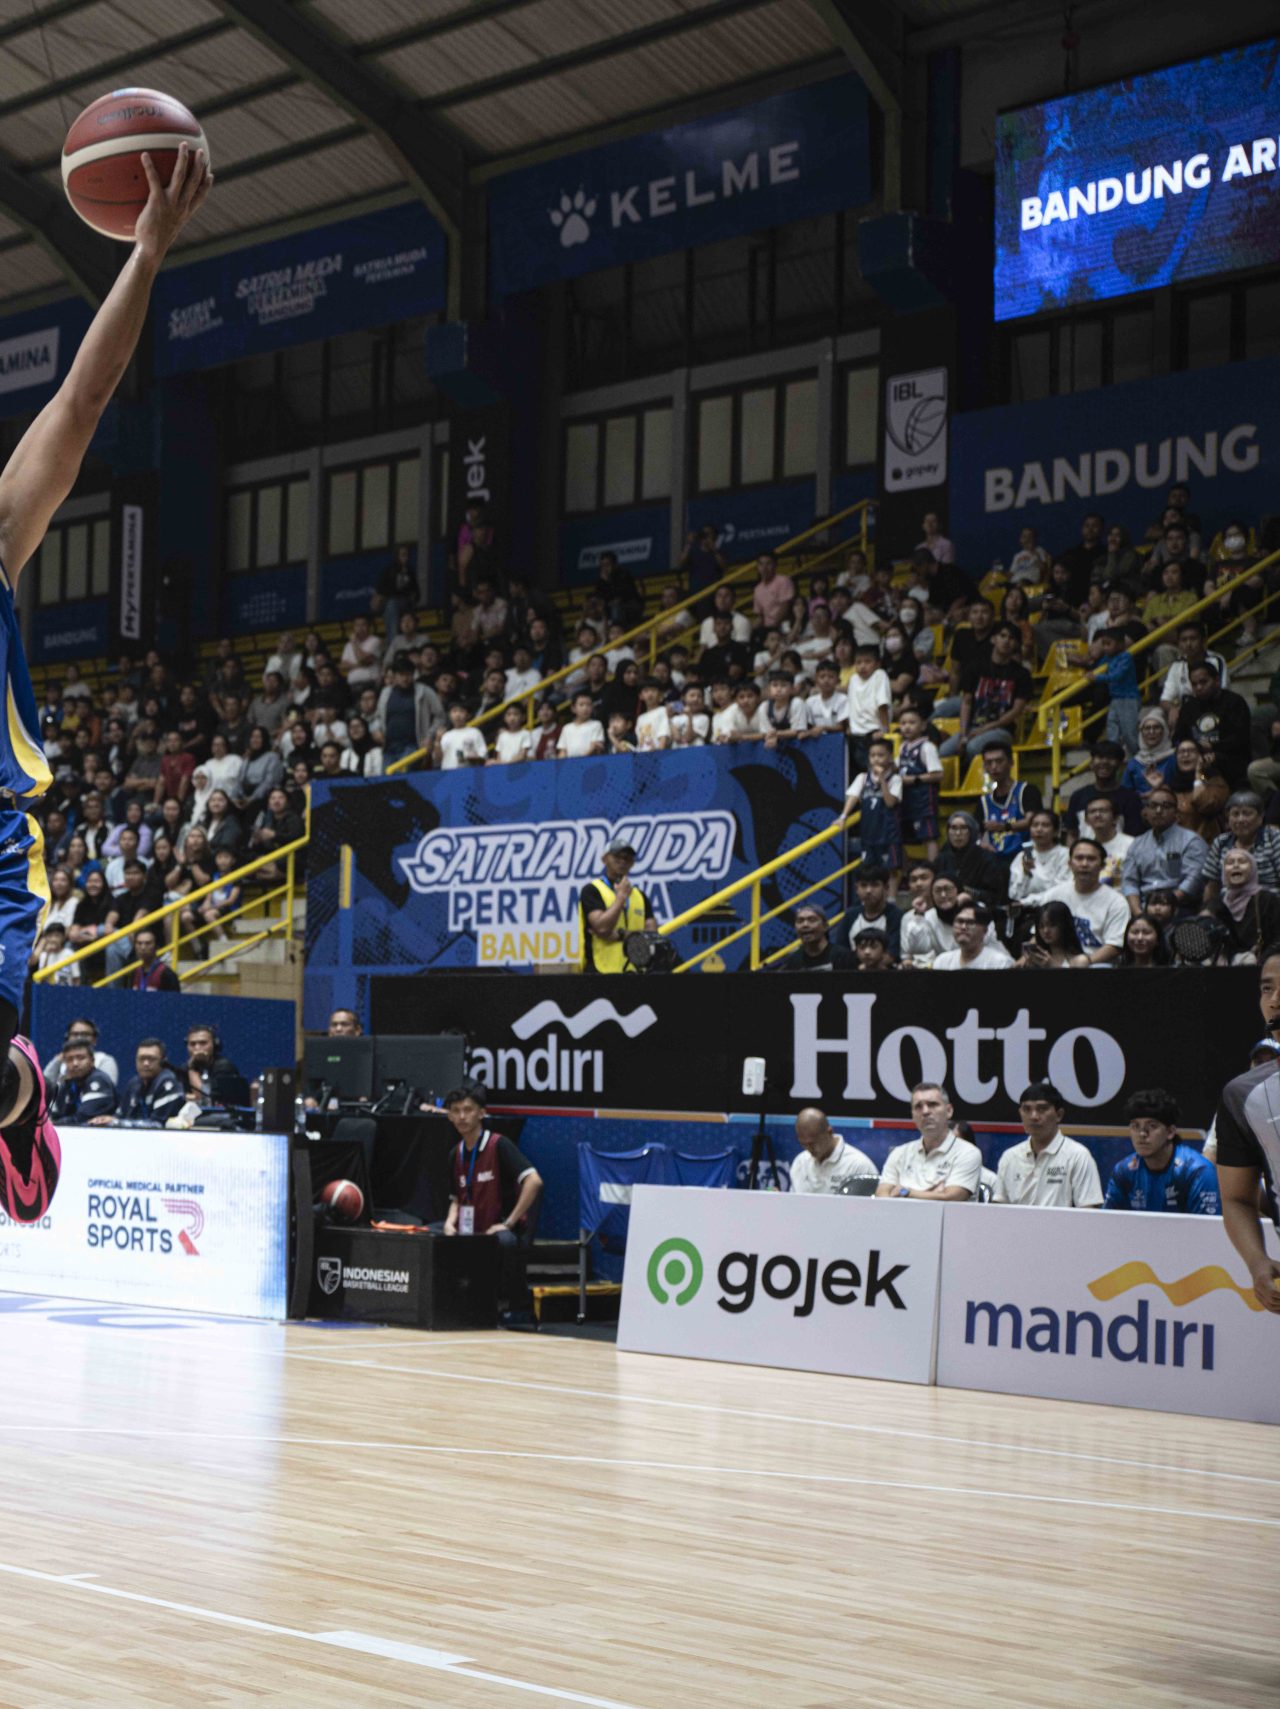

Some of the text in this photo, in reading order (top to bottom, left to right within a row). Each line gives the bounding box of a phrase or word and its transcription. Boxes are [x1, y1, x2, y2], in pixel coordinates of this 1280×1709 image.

[609, 139, 801, 229] KELME
[1021, 152, 1213, 231] BANDUNG
[894, 382, 924, 401] IBL
[983, 422, 1261, 514] BANDUNG
[481, 932, 580, 962] BANDU
[464, 1033, 604, 1093] andiri
[789, 993, 1127, 1108] Hotto
[87, 1178, 205, 1195] OFFICIAL MEDICAL PARTNER
[87, 1194, 157, 1223] ROYAL
[87, 1223, 173, 1254] SPORTS
[342, 1266, 410, 1284] INDONESIAN
[342, 1279, 409, 1293] BASKETBALL LEAGUE
[717, 1249, 911, 1318] gojek
[965, 1299, 1216, 1371] mandiri
